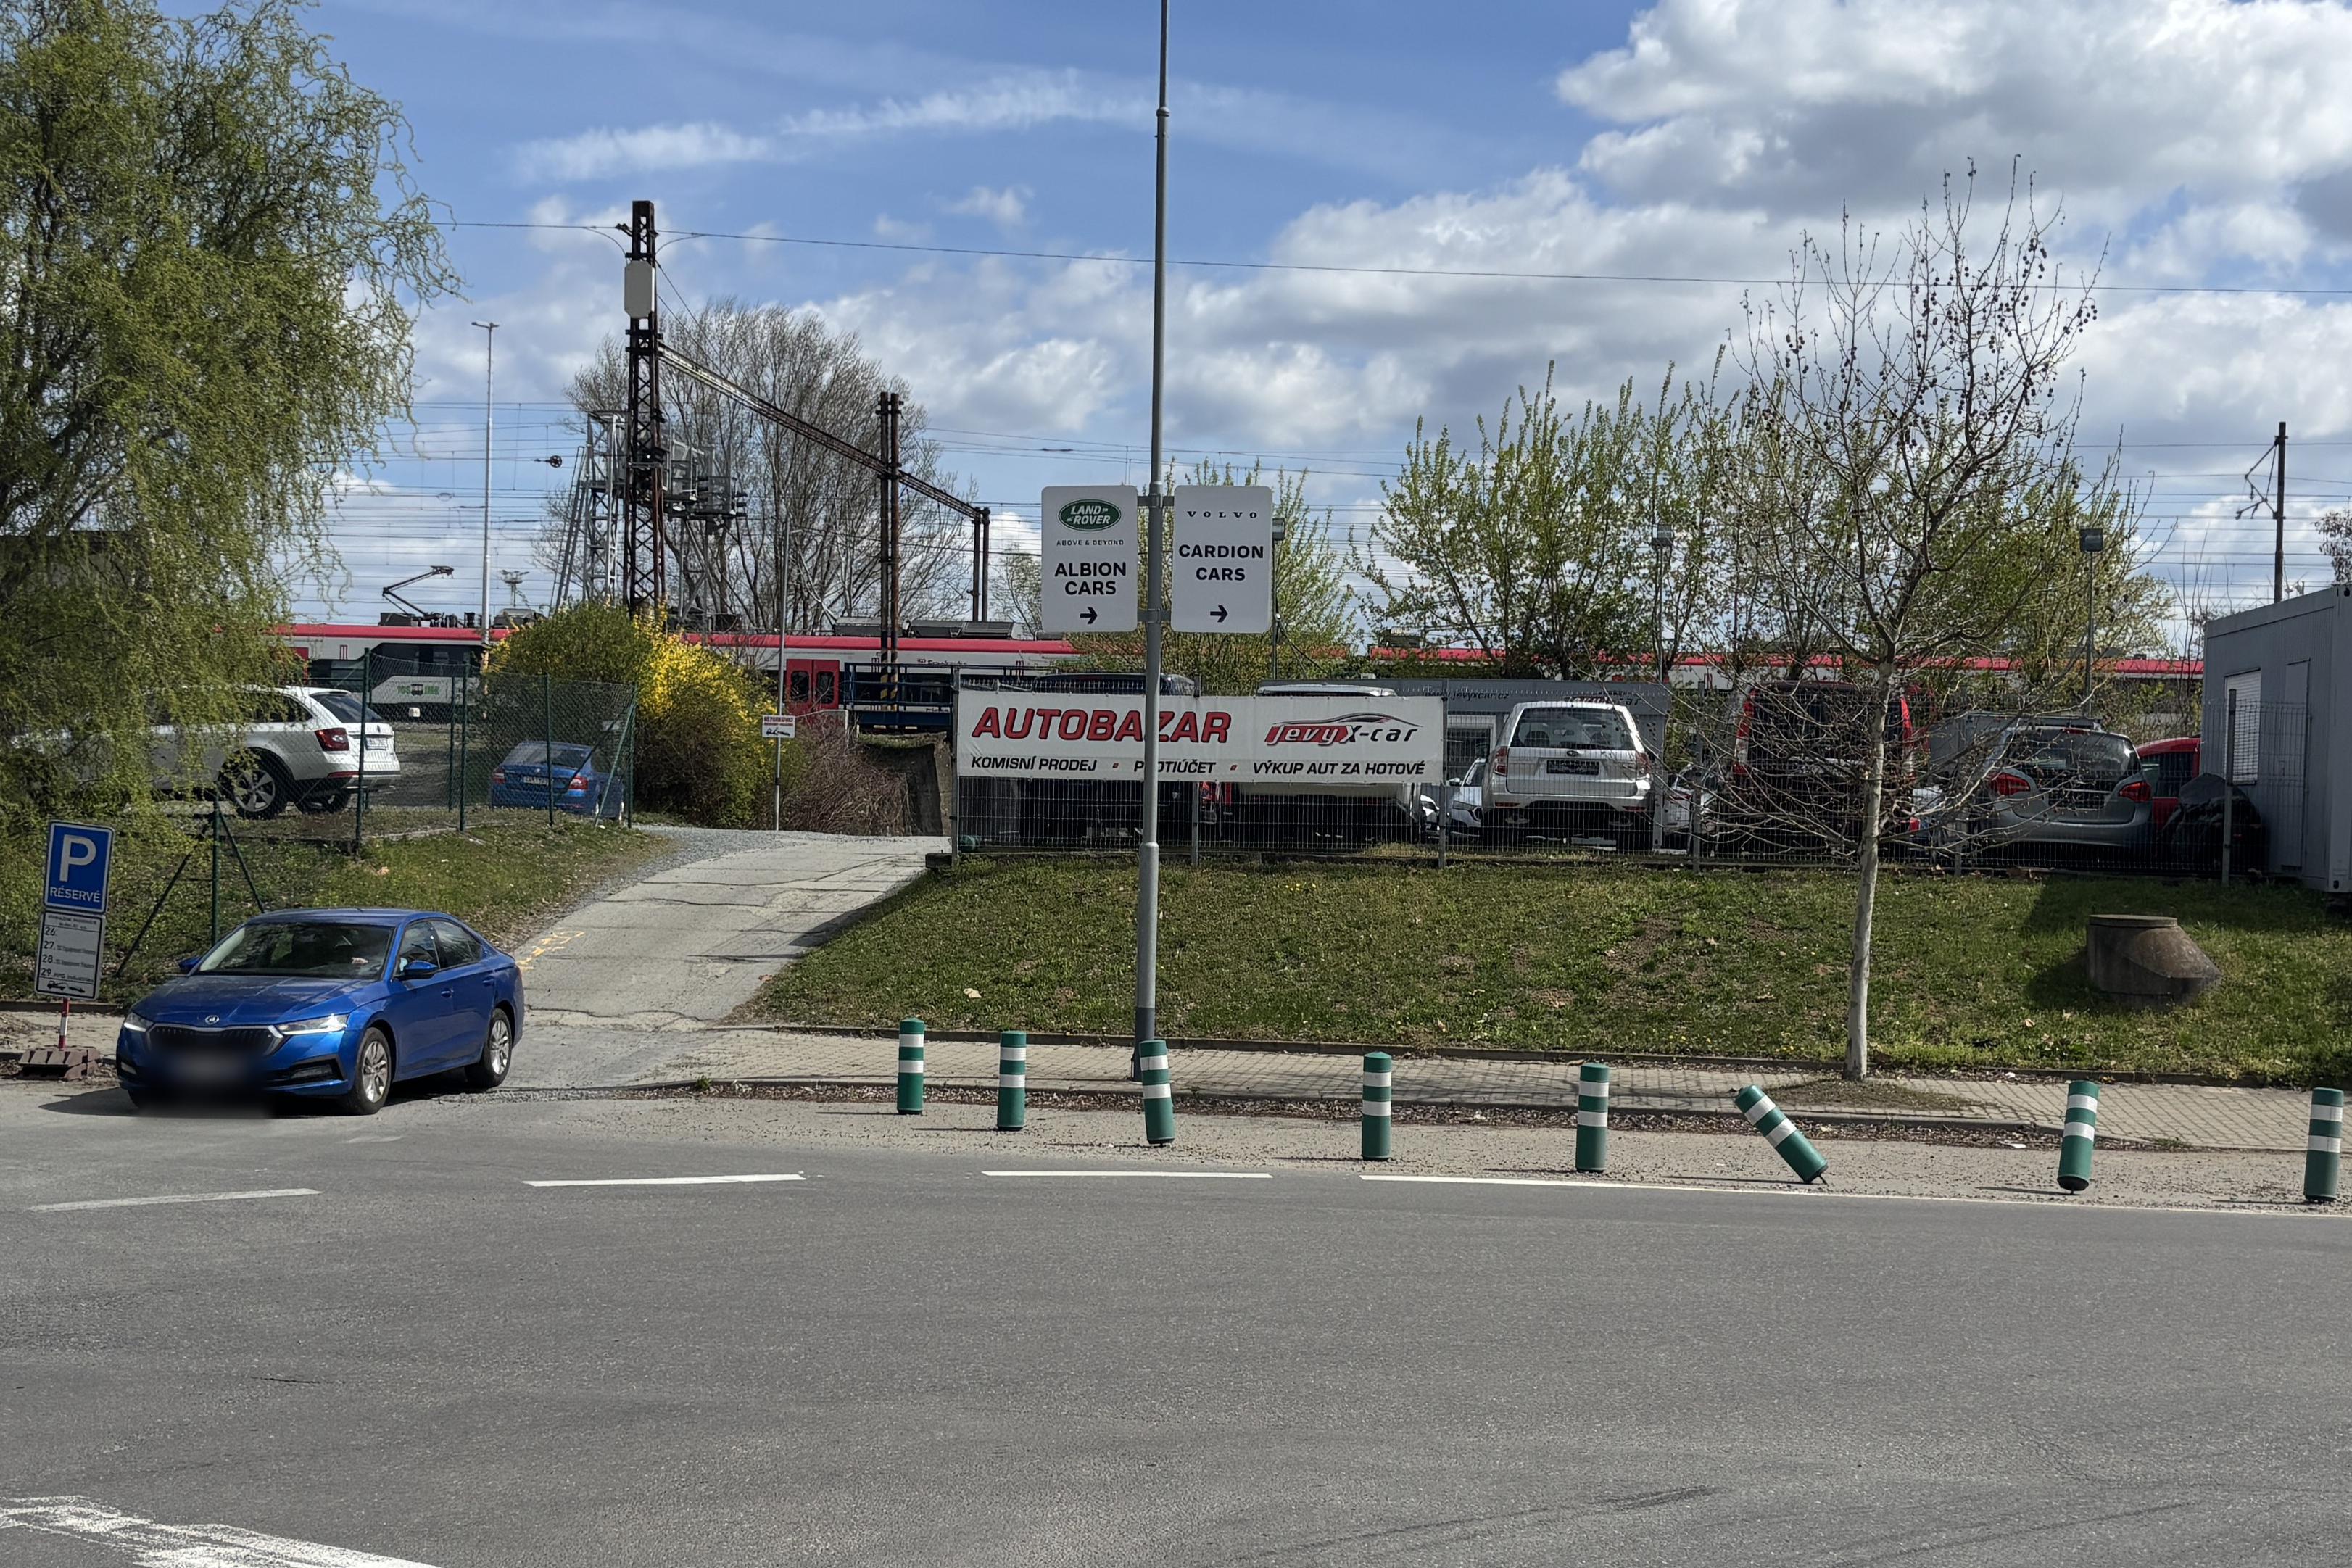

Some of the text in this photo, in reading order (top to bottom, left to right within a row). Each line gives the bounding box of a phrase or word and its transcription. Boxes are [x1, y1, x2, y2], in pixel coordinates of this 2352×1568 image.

[1070, 505, 1101, 515] LAND
[1187, 510, 1257, 519] VOLVO
[1073, 515, 1110, 524] ROVER
[1179, 544, 1264, 559] CARDION
[1054, 562, 1126, 577] ALBION
[1196, 567, 1246, 581] CARS
[1065, 581, 1116, 595] CARS
[972, 707, 1232, 743] AUTOBAZAR
[972, 756, 1425, 774] KOMISNÍ PRODEJ PTIÚČET VÝKUP AUT ZA HOTOVÉ
[59, 834, 96, 882] P
[50, 885, 101, 903] RÉSERVÉ
